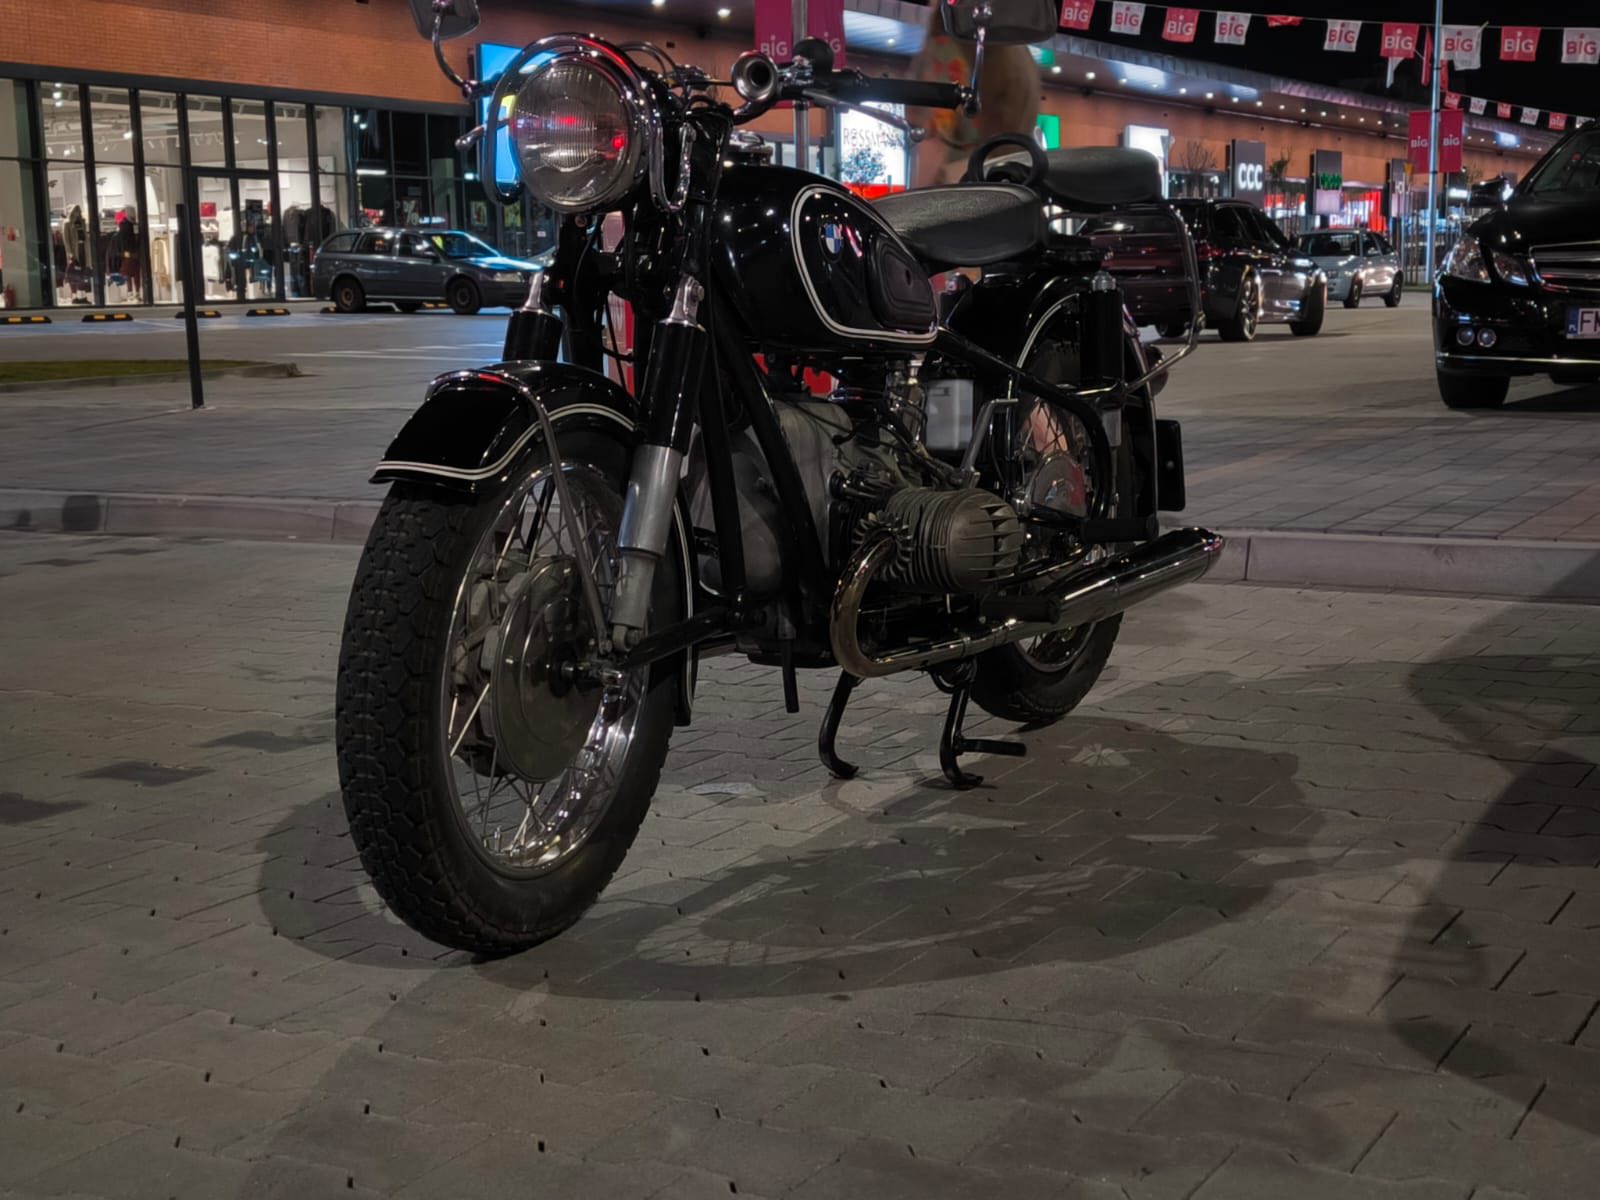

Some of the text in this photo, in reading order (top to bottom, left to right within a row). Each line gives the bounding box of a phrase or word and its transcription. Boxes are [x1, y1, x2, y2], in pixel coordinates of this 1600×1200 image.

[1064, 2, 1089, 22] BIG
[1115, 6, 1140, 27] BIG
[1167, 15, 1194, 36] BIG
[1218, 16, 1244, 37] BIG
[1328, 22, 1355, 44] BIG
[760, 34, 787, 56] BIG
[1384, 28, 1413, 50] BIG
[1444, 31, 1473, 52] BIG
[1504, 31, 1534, 53] BIG
[1566, 33, 1598, 55] BIG
[1443, 133, 1460, 147] BIG
[1238, 162, 1264, 191] CCC
